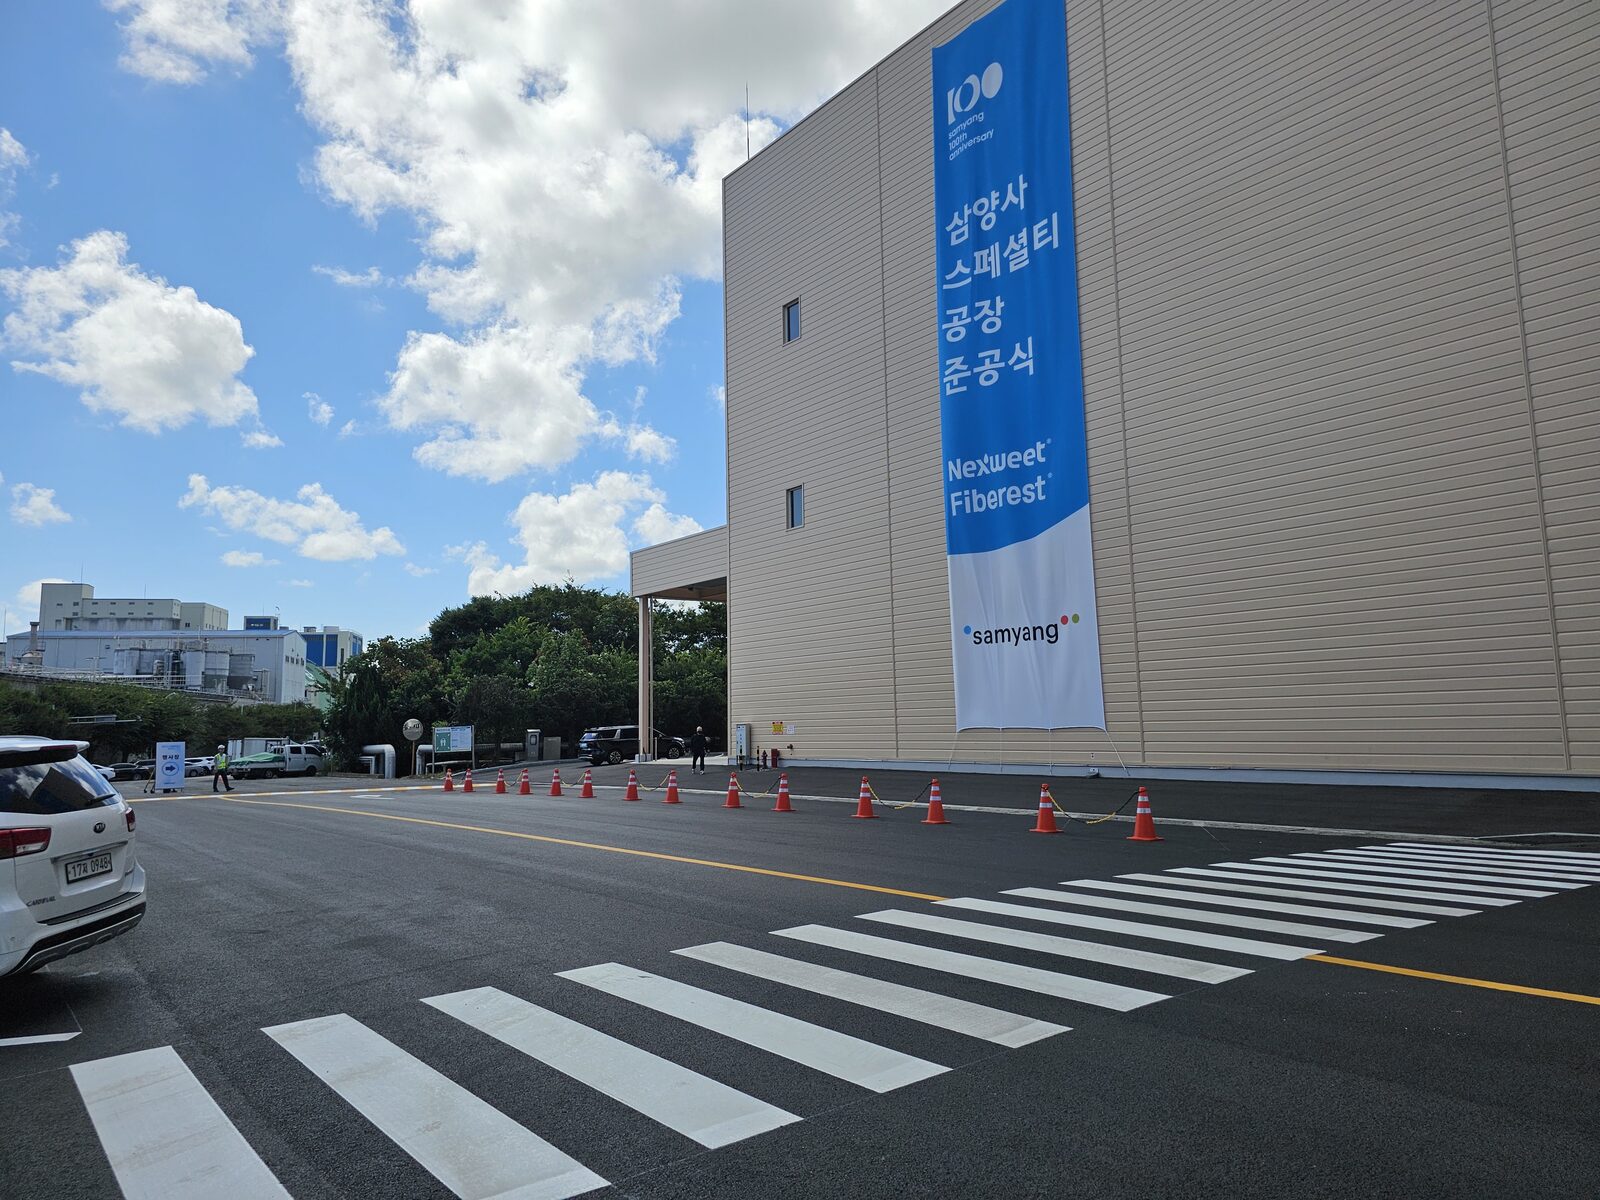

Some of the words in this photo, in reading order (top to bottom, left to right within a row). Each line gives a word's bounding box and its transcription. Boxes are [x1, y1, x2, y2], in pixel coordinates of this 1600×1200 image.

[948, 111, 984, 139] samyang
[948, 131, 968, 151] 100th
[948, 128, 994, 161] anniversary
[945, 173, 1028, 246] 삼양사
[942, 211, 1059, 290] 스페셜티
[942, 295, 1005, 343] 공장
[943, 336, 1034, 396] 준공식
[948, 441, 1046, 482] Nexweet
[950, 475, 1046, 516] Fiberest
[972, 623, 1059, 646] samyang
[90, 857, 108, 872] 0948
